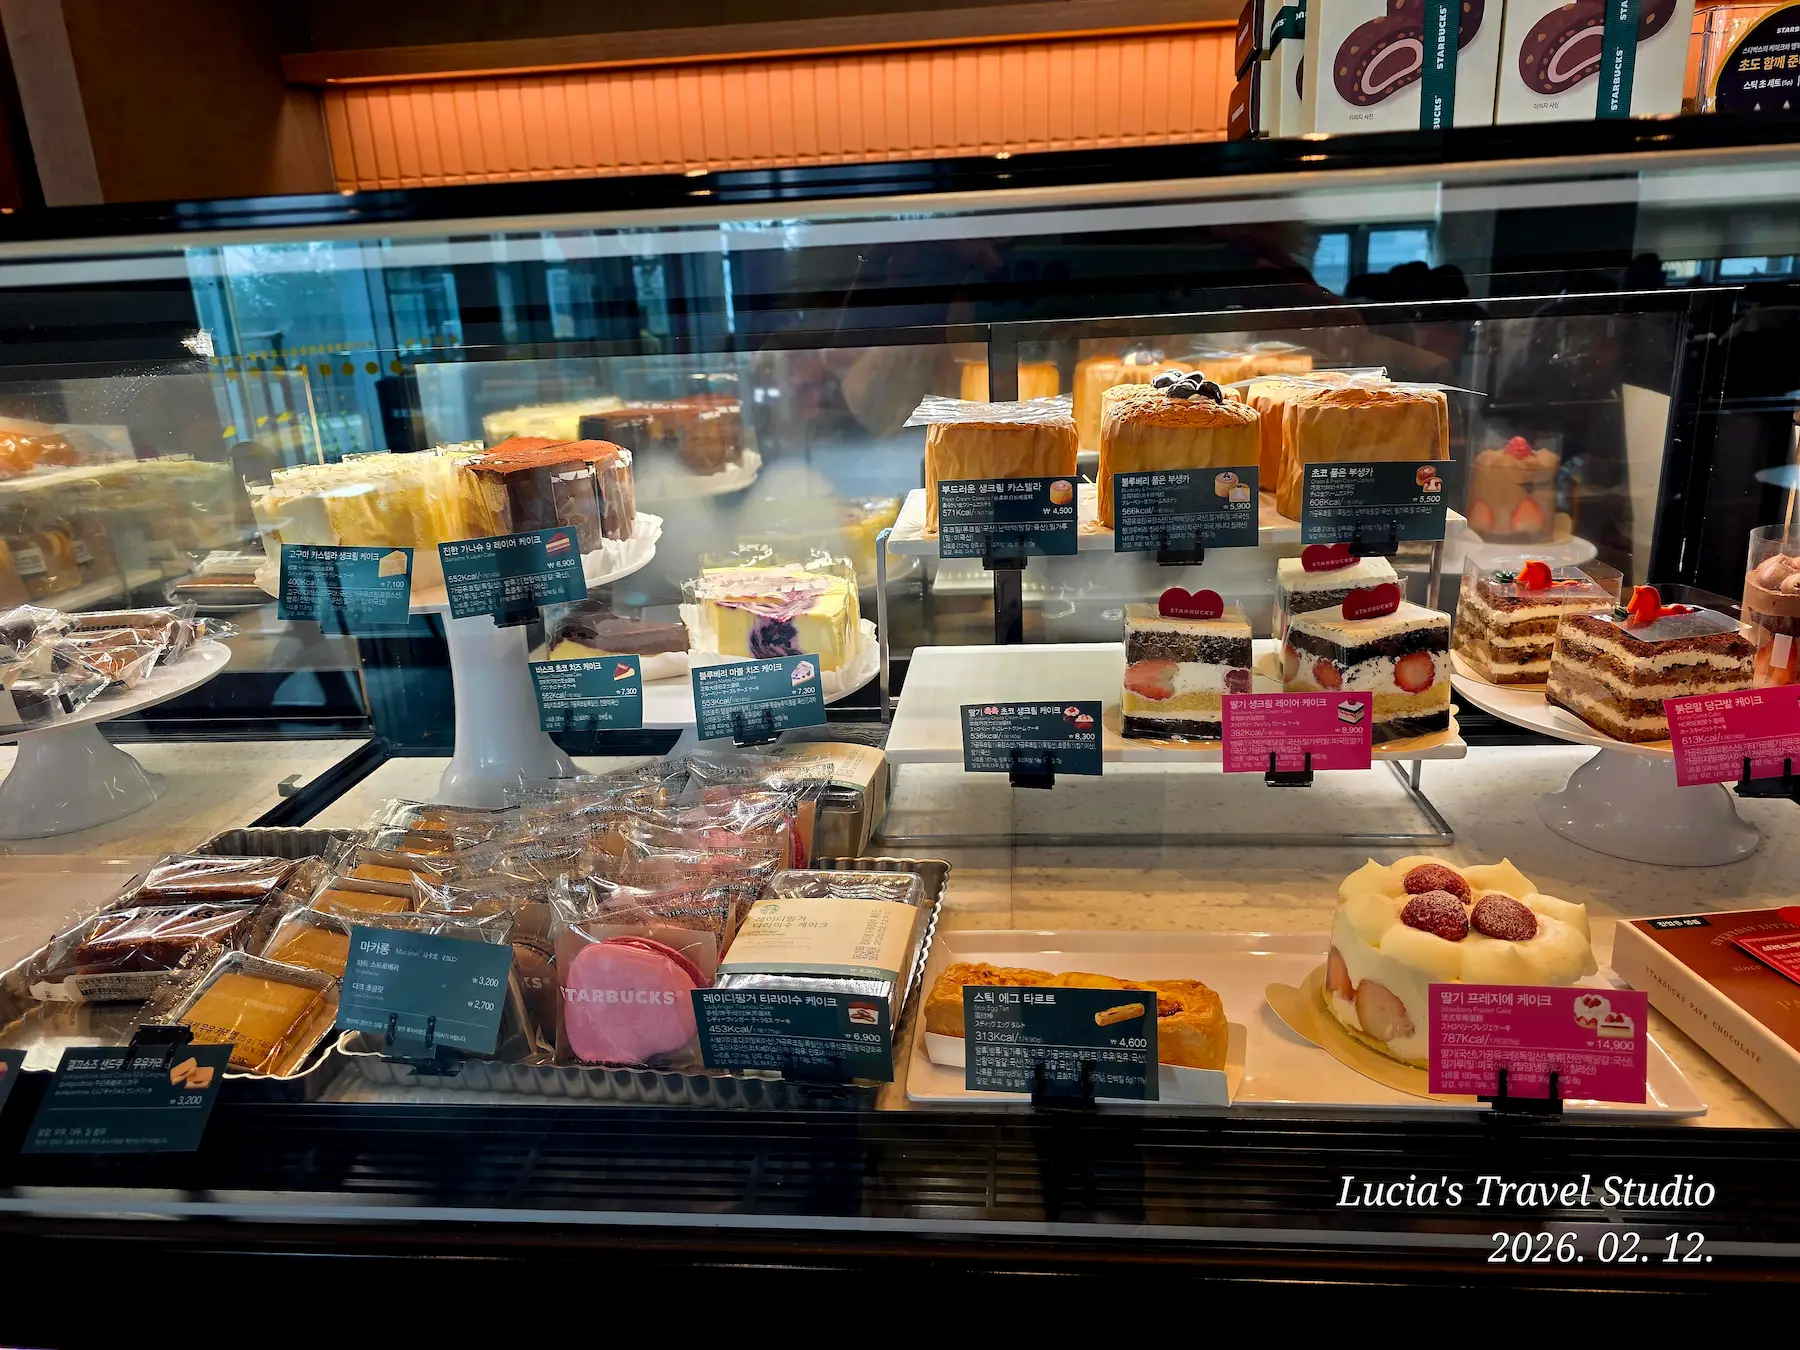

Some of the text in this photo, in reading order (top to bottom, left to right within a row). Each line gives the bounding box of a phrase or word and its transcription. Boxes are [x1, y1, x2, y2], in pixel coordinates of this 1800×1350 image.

[1436, 6, 1447, 70] STARBUCKS
[1742, 42, 1790, 55] 스타벅스의 케이크와
[1738, 54, 1800, 72] 초도 함께 준
[1610, 48, 1624, 111] STARBUCKS
[1743, 79, 1767, 90] 스틱 초
[1311, 467, 1374, 478] 초코 품은 부생카
[1121, 476, 1150, 487] 블루베리
[1151, 475, 1166, 485] 품은
[941, 482, 1041, 494] 부드러운 생크림 카스텔라
[1419, 495, 1441, 503] 5,500
[1053, 507, 1073, 515] 4,500
[443, 546, 458, 556] 진한
[461, 543, 483, 553] 가나슈
[494, 540, 517, 550] 레이어
[519, 535, 541, 546] 케이크
[289, 550, 379, 561] 고구마 카스텔라 생크림 케이크
[1312, 557, 1353, 567] STARBUCKS
[1169, 607, 1215, 616] STARBUCKS
[1354, 602, 1394, 615] STARBUCKS
[556, 664, 569, 672] 초코
[569, 663, 581, 671] 치즈
[583, 662, 602, 670] 케이크
[699, 663, 783, 680] 블루베리 마블 치즈 케이크
[797, 687, 816, 695] 7,300
[1230, 698, 1327, 709] 딸기 생크림 레이어 케이크
[1675, 703, 1702, 714] 붉은말
[1735, 696, 1764, 707] 케이크
[968, 709, 983, 717] 딸기
[1001, 707, 1015, 715] 초코
[1017, 707, 1037, 716] 생크림
[1040, 706, 1061, 715] 케이크
[1341, 726, 1364, 734] 8,900
[1711, 924, 1756, 947] EVERYDAY
[360, 941, 390, 956] 마카롱
[356, 959, 400, 972] 하트 스트로베리
[352, 982, 384, 994] 다크 초콜릿
[478, 976, 499, 988] 3,200
[703, 993, 838, 1007] 레이디핑거 티라미수 케이크
[973, 992, 1056, 1005] 스틱 에그 타르트
[1441, 992, 1553, 1007] 딸기 프레지에 케이크
[474, 1000, 495, 1011] 2,700
[1645, 966, 1762, 1064] STARBUCKS PAVE CHOCOLATE
[200, 1023, 215, 1034] 우유
[853, 1032, 881, 1042] 6,900
[1119, 1038, 1147, 1048] 4,600
[1597, 1039, 1634, 1050] 14,900
[177, 1095, 202, 1106] 3,200
